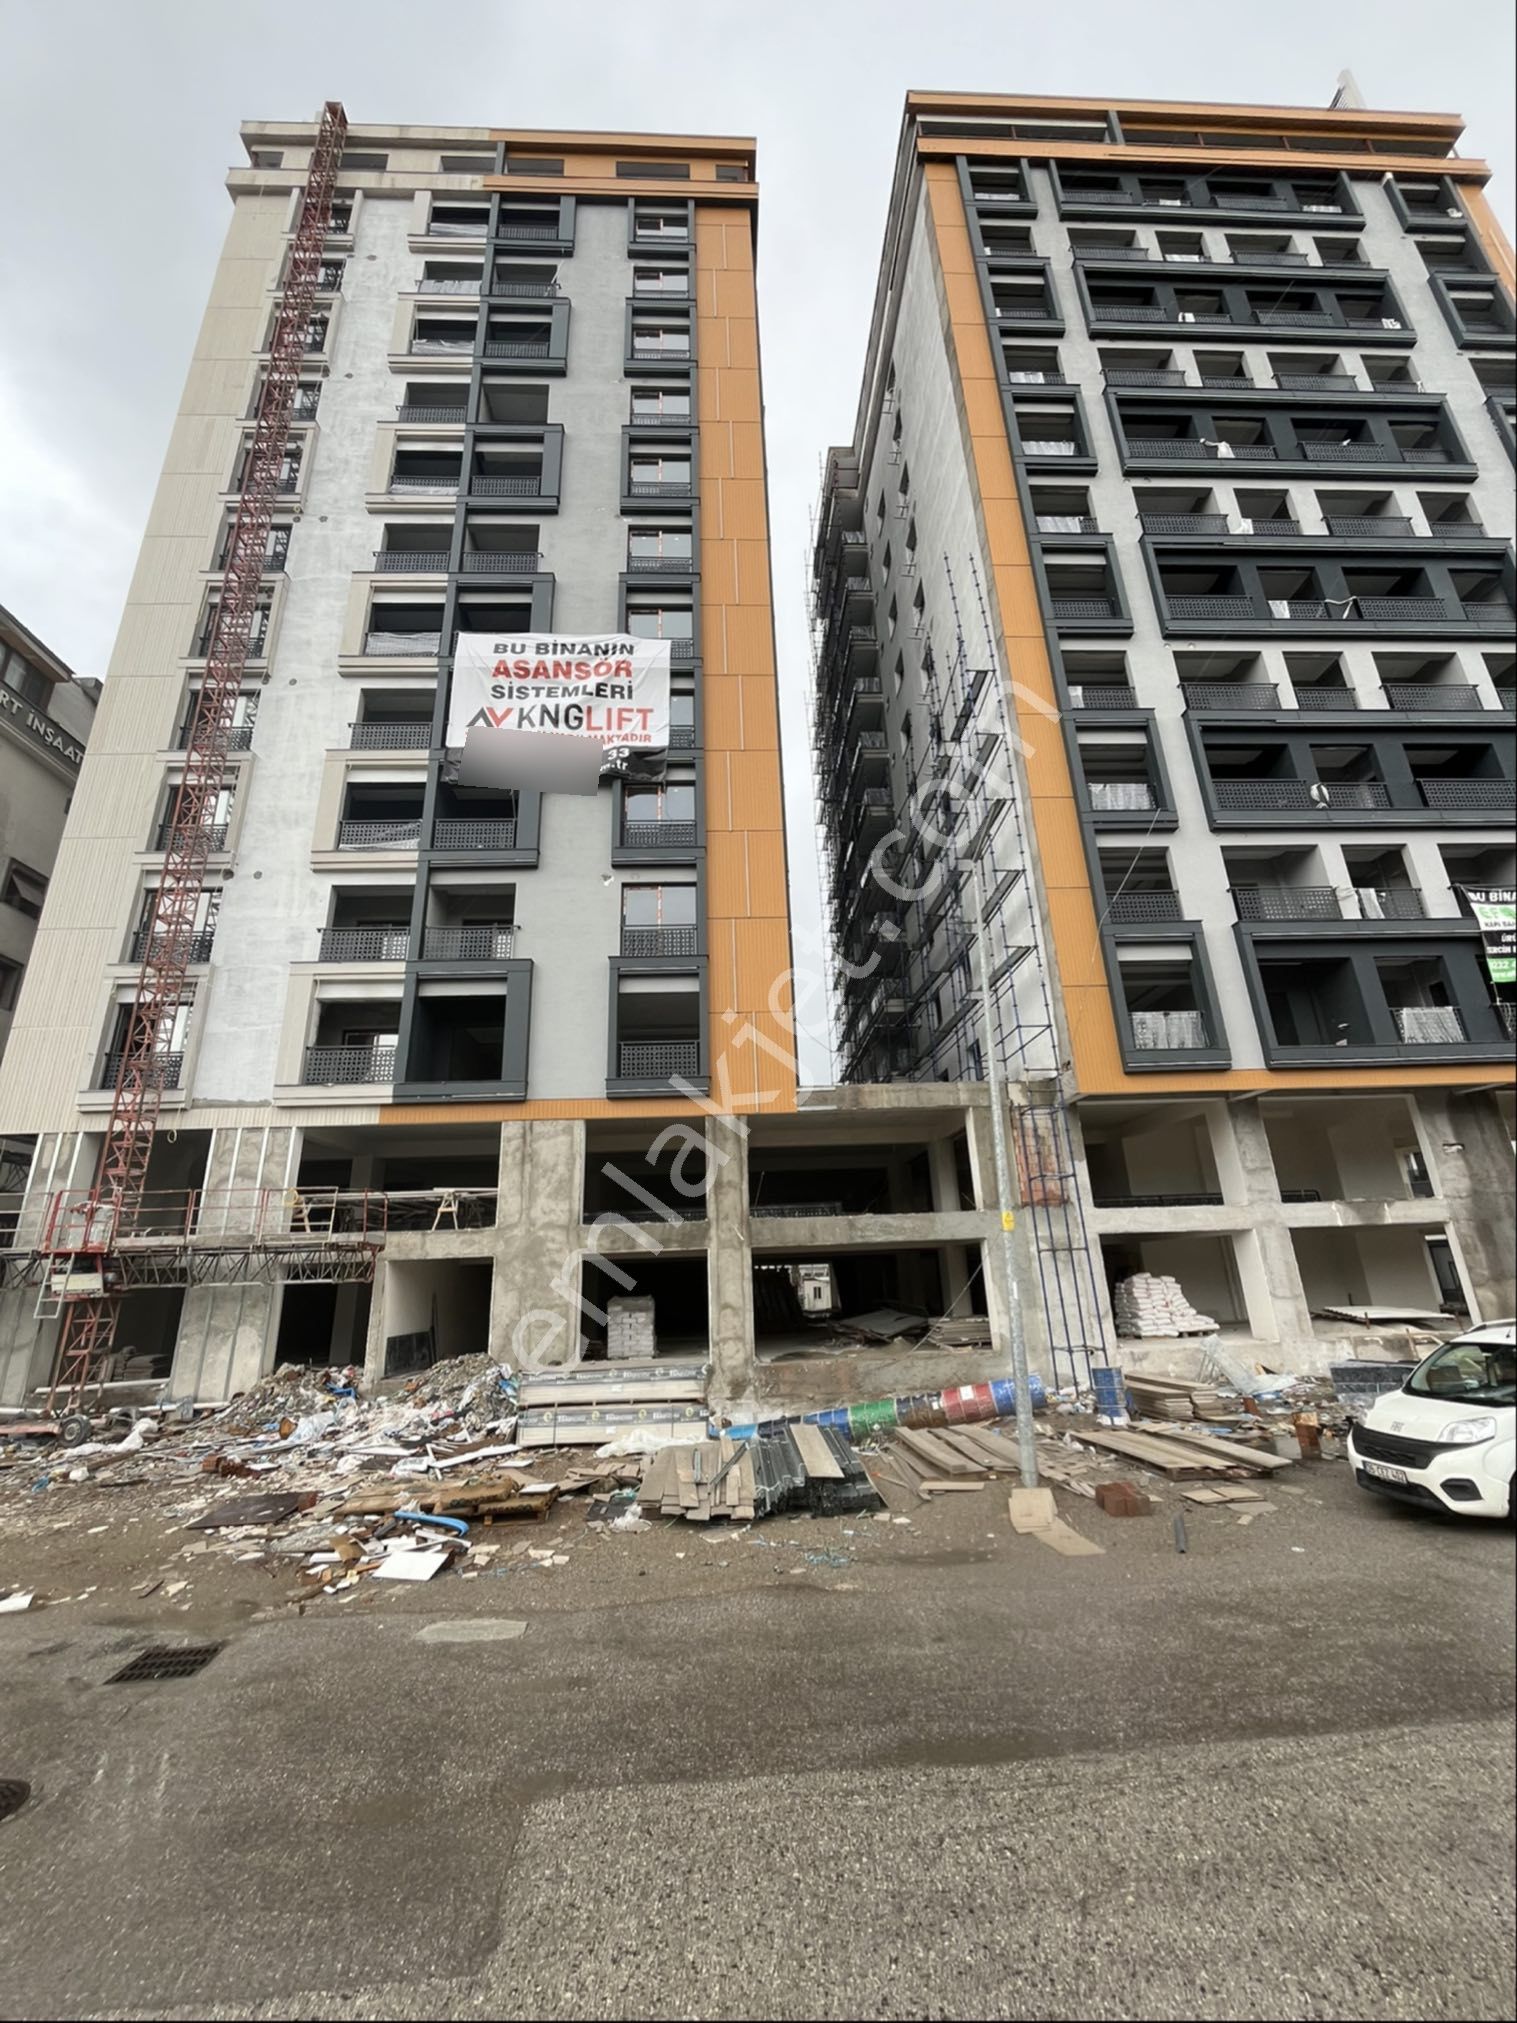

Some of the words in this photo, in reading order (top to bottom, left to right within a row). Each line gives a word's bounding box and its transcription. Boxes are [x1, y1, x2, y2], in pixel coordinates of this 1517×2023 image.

[493, 643, 526, 655] BU
[535, 640, 635, 656] BİNANIN
[492, 657, 633, 680] ASANSÖR
[490, 681, 633, 700] SİSTEMLERİ
